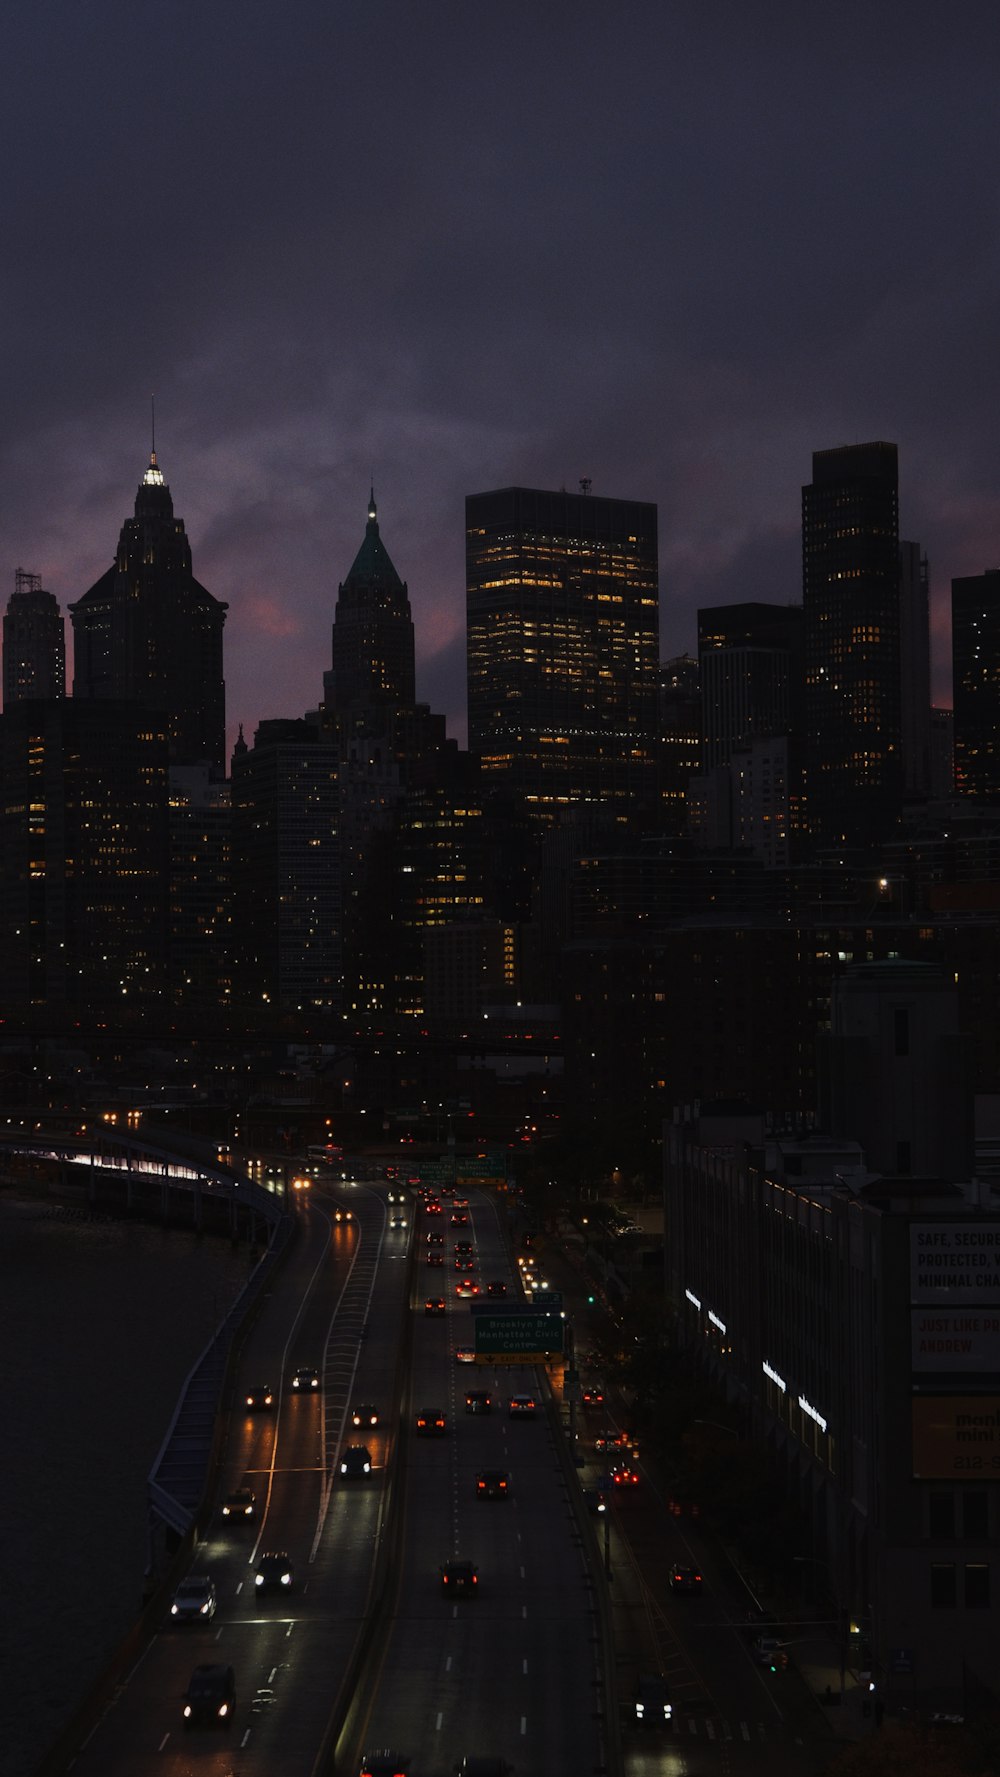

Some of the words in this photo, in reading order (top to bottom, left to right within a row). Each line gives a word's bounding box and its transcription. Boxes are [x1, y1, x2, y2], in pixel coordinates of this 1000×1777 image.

[917, 1233, 951, 1248] SAFE,
[918, 1253, 990, 1268] PROTECTED,
[918, 1274, 973, 1288] MINIMAL
[552, 1294, 560, 1302] 2
[490, 1320, 533, 1329] Brooklyn
[537, 1320, 548, 1328] Br
[919, 1319, 950, 1332] JUST
[953, 1319, 980, 1332] LIKE
[479, 1331, 531, 1339] Manhattan
[503, 1341, 535, 1349] Center
[919, 1339, 973, 1353] ANDREW
[956, 1427, 994, 1442] mini
